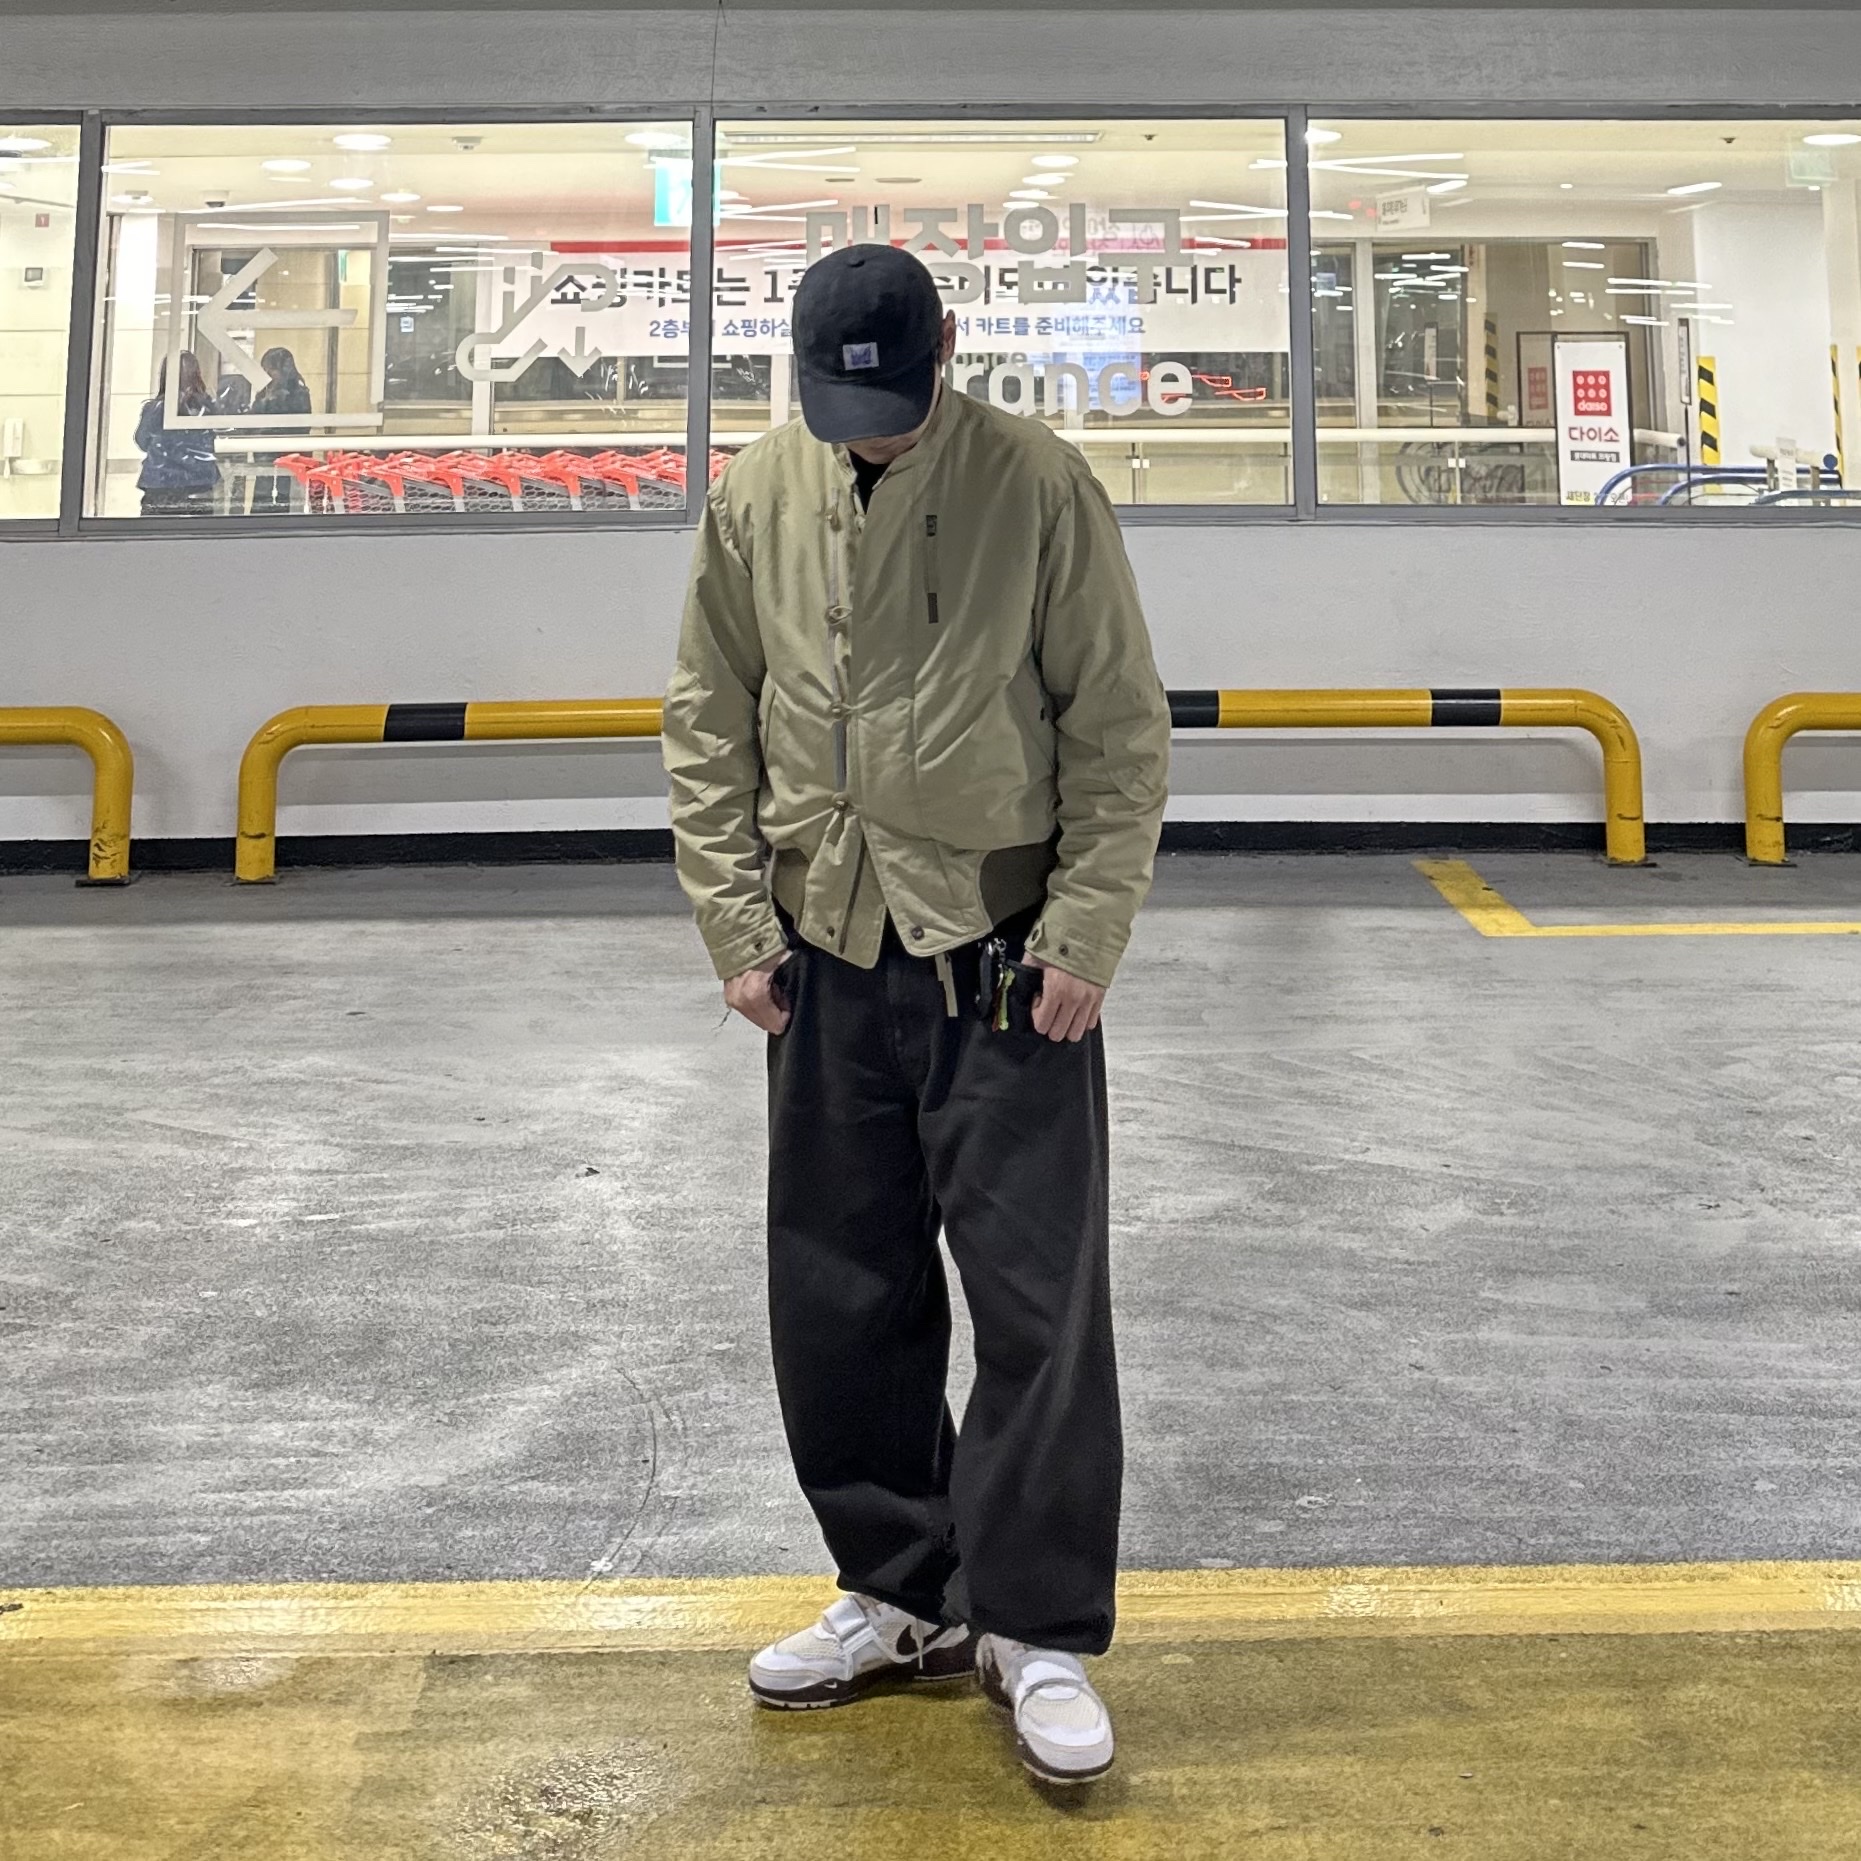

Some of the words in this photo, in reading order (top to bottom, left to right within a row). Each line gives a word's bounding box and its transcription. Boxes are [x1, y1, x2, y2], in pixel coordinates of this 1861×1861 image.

[976, 316, 1031, 336] 카트를
[1577, 399, 1608, 412] daiso
[1568, 426, 1620, 443] 다이소
